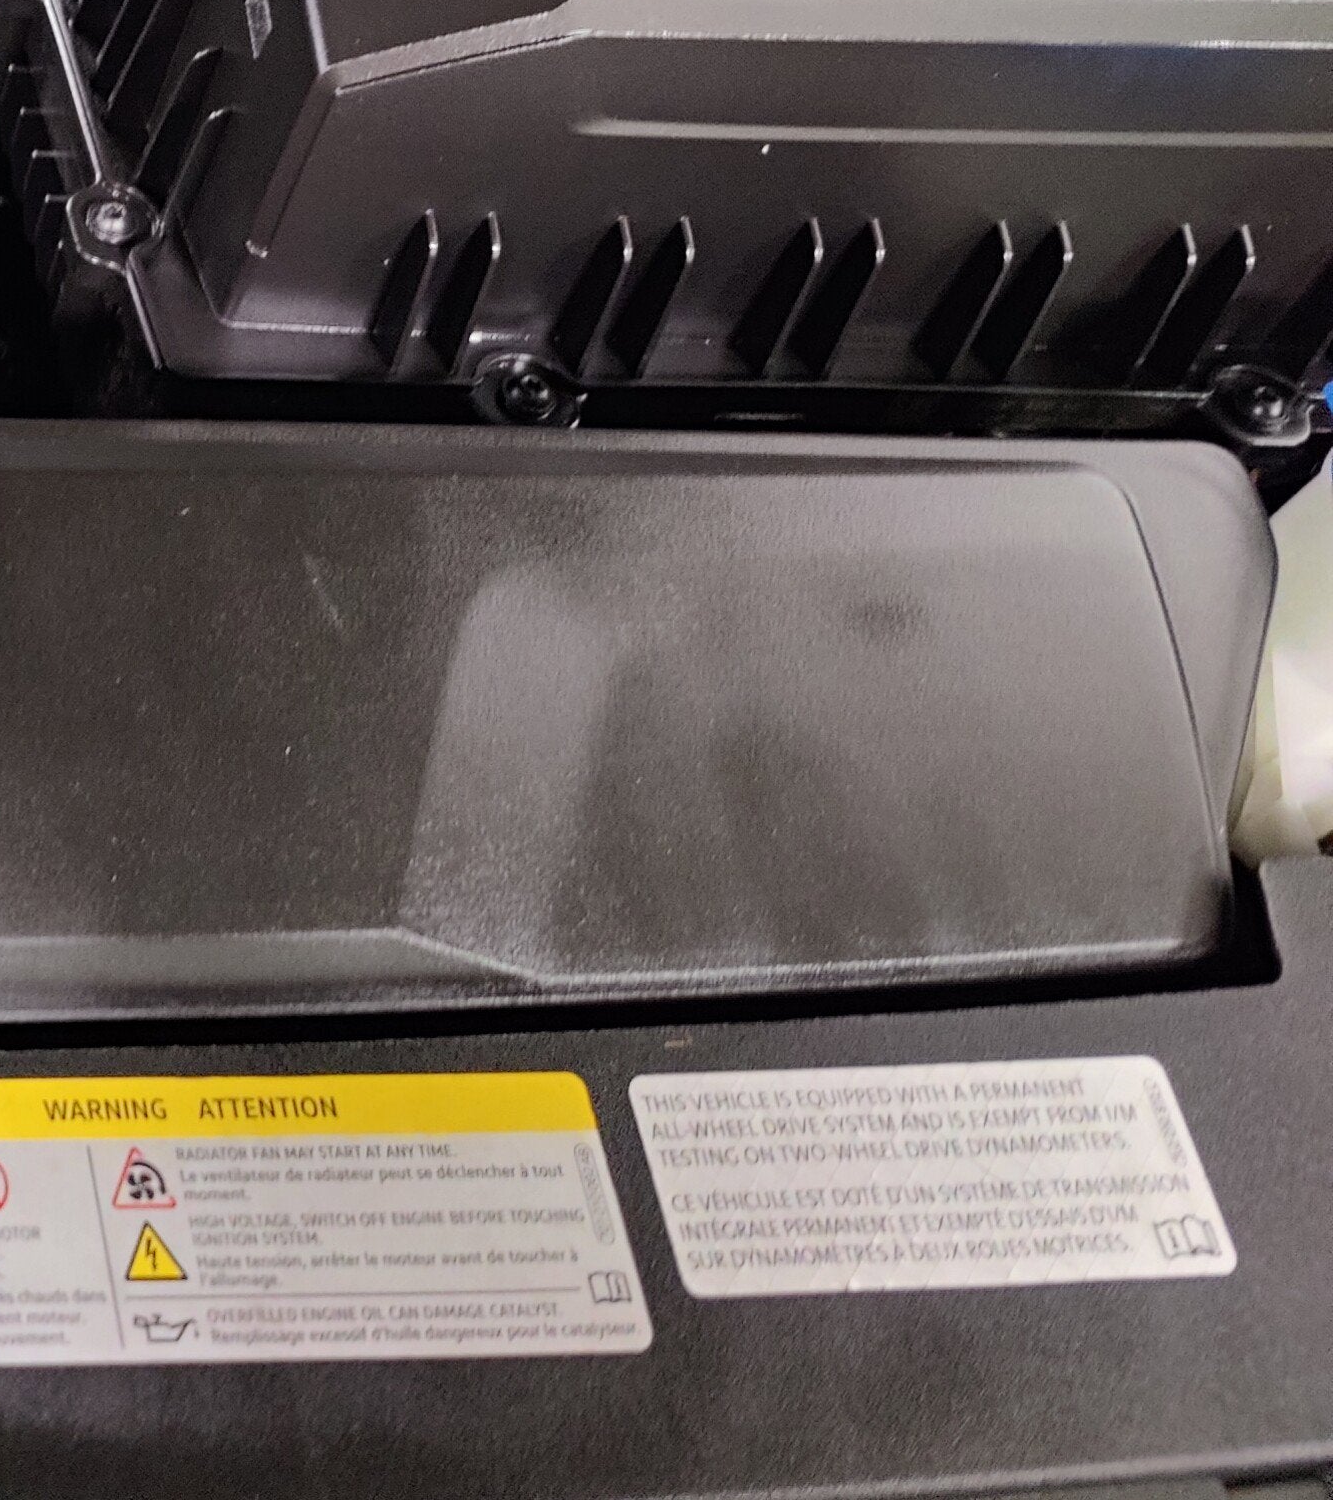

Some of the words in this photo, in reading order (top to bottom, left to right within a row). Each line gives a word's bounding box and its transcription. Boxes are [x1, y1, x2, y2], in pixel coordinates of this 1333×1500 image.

[43, 1098, 169, 1121] WARNING
[198, 1096, 339, 1120] ATTENTION
[642, 1092, 686, 1114] THIS
[690, 1089, 768, 1112] VEHICLE
[774, 1089, 791, 1108] IS
[796, 1085, 892, 1110] EQUIPPED
[896, 1083, 947, 1104] WITH
[951, 1083, 966, 1102] A
[174, 1145, 247, 1161] RADIATOR
[318, 1144, 362, 1159] START
[364, 1144, 381, 1158] AT
[385, 1143, 414, 1158] ANY
[658, 1145, 738, 1169] TESTING
[670, 1193, 694, 1213] CE
